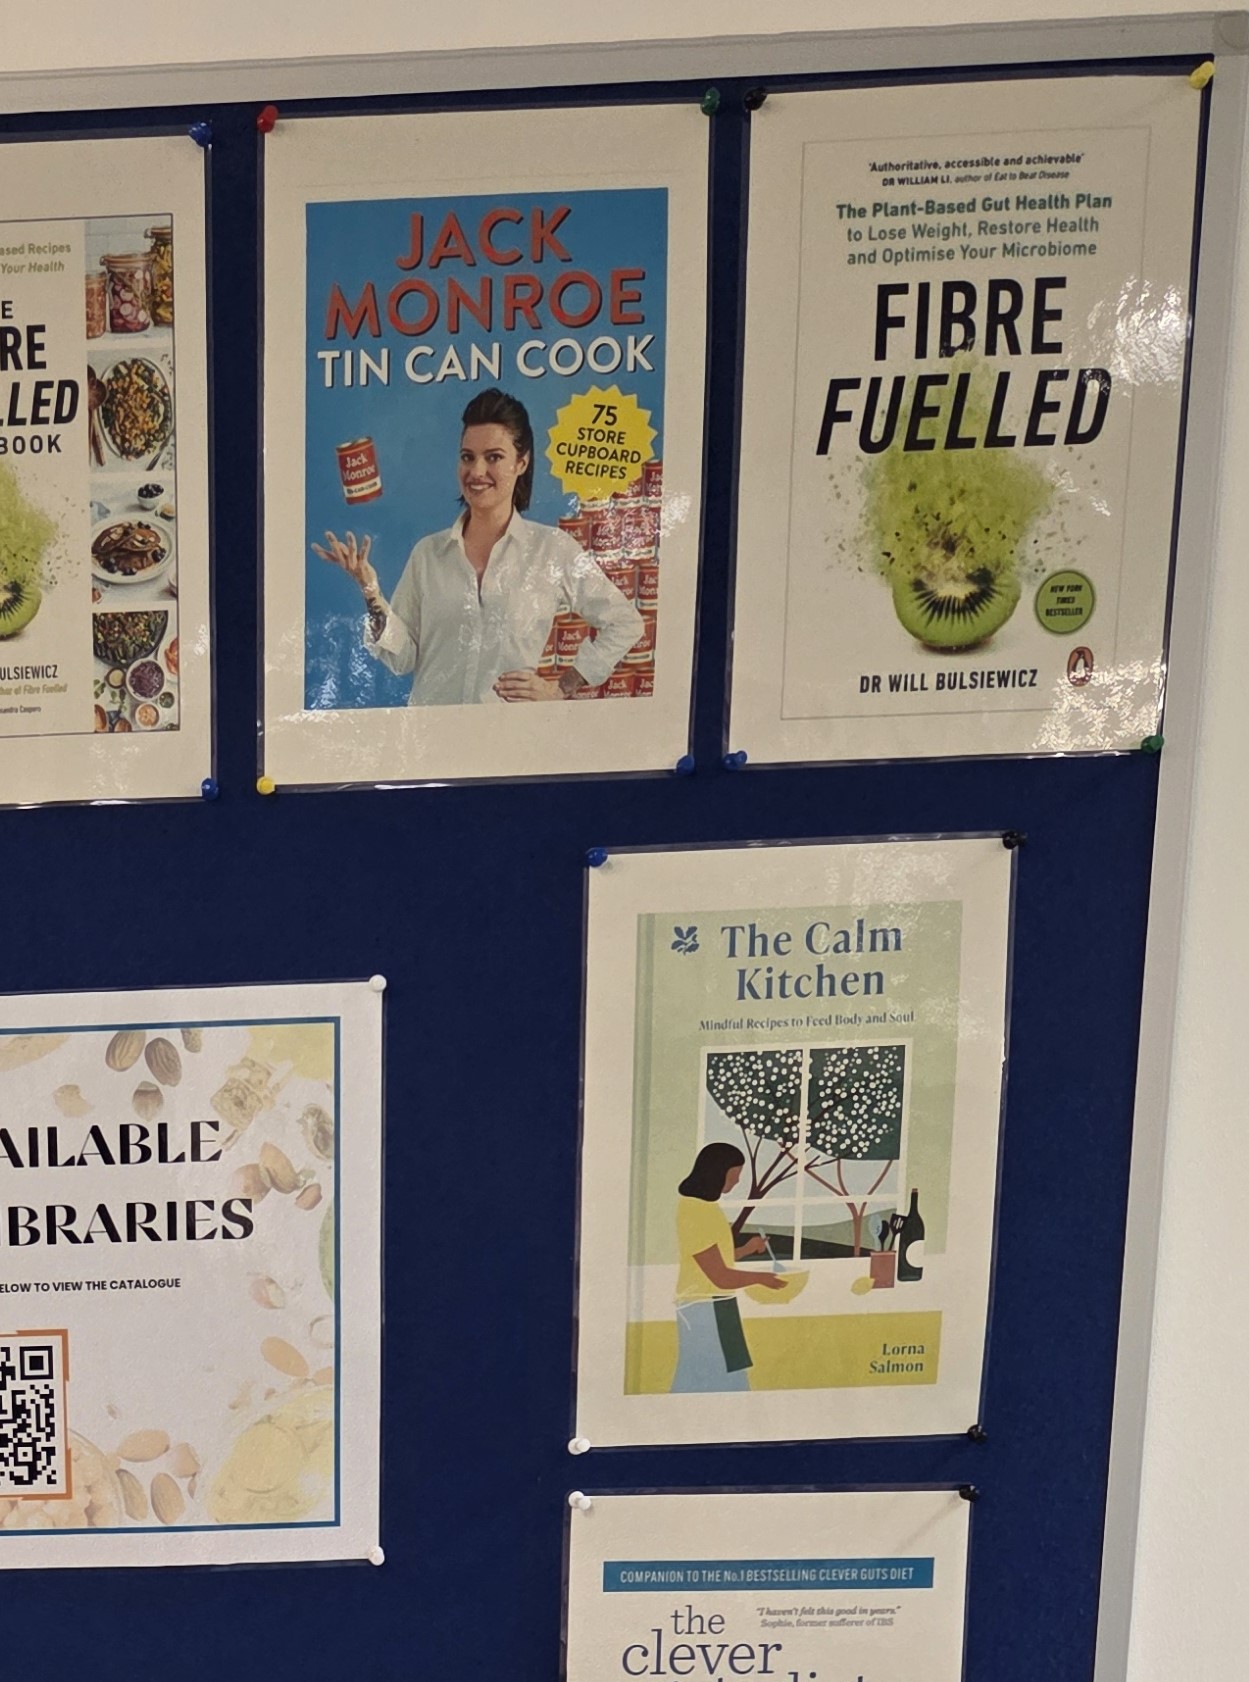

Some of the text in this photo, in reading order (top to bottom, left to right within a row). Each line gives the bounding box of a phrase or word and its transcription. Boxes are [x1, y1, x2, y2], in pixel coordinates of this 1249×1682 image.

[837, 194, 1112, 220] The Plant-Based Gut Health Plan
[396, 206, 572, 270] JACK
[847, 217, 1099, 243] to Lose Weight, Restore Health
[324, 268, 646, 339] MONROE
[874, 277, 1066, 361] FIBRE
[317, 335, 655, 387] TIN CAN COOK
[593, 404, 617, 426] 75
[816, 368, 1112, 456] FUELLED
[577, 428, 625, 444] STORE
[556, 442, 641, 464] CUPBOARD
[565, 461, 626, 480] RECIPES
[860, 669, 1038, 693] DR WILL BULSIEWICZ
[721, 920, 903, 958] The Calm
[736, 964, 884, 1001] Kitchen
[34, 1282, 50, 1294] TO
[53, 1281, 82, 1294] VIEW
[85, 1281, 107, 1292] THE
[110, 1278, 181, 1292] CATALOGUE
[882, 1342, 925, 1357] Lorna
[869, 1359, 923, 1375] Salmon
[620, 1569, 684, 1584] COMPANION
[687, 1570, 699, 1582] TO
[702, 1570, 721, 1581] THE
[747, 1568, 816, 1582] BESTSELLING
[819, 1568, 857, 1580] CLEVER
[860, 1567, 887, 1579] GUTS
[890, 1566, 913, 1579] DIET
[672, 1605, 725, 1635] the
[622, 1629, 782, 1677] clever
